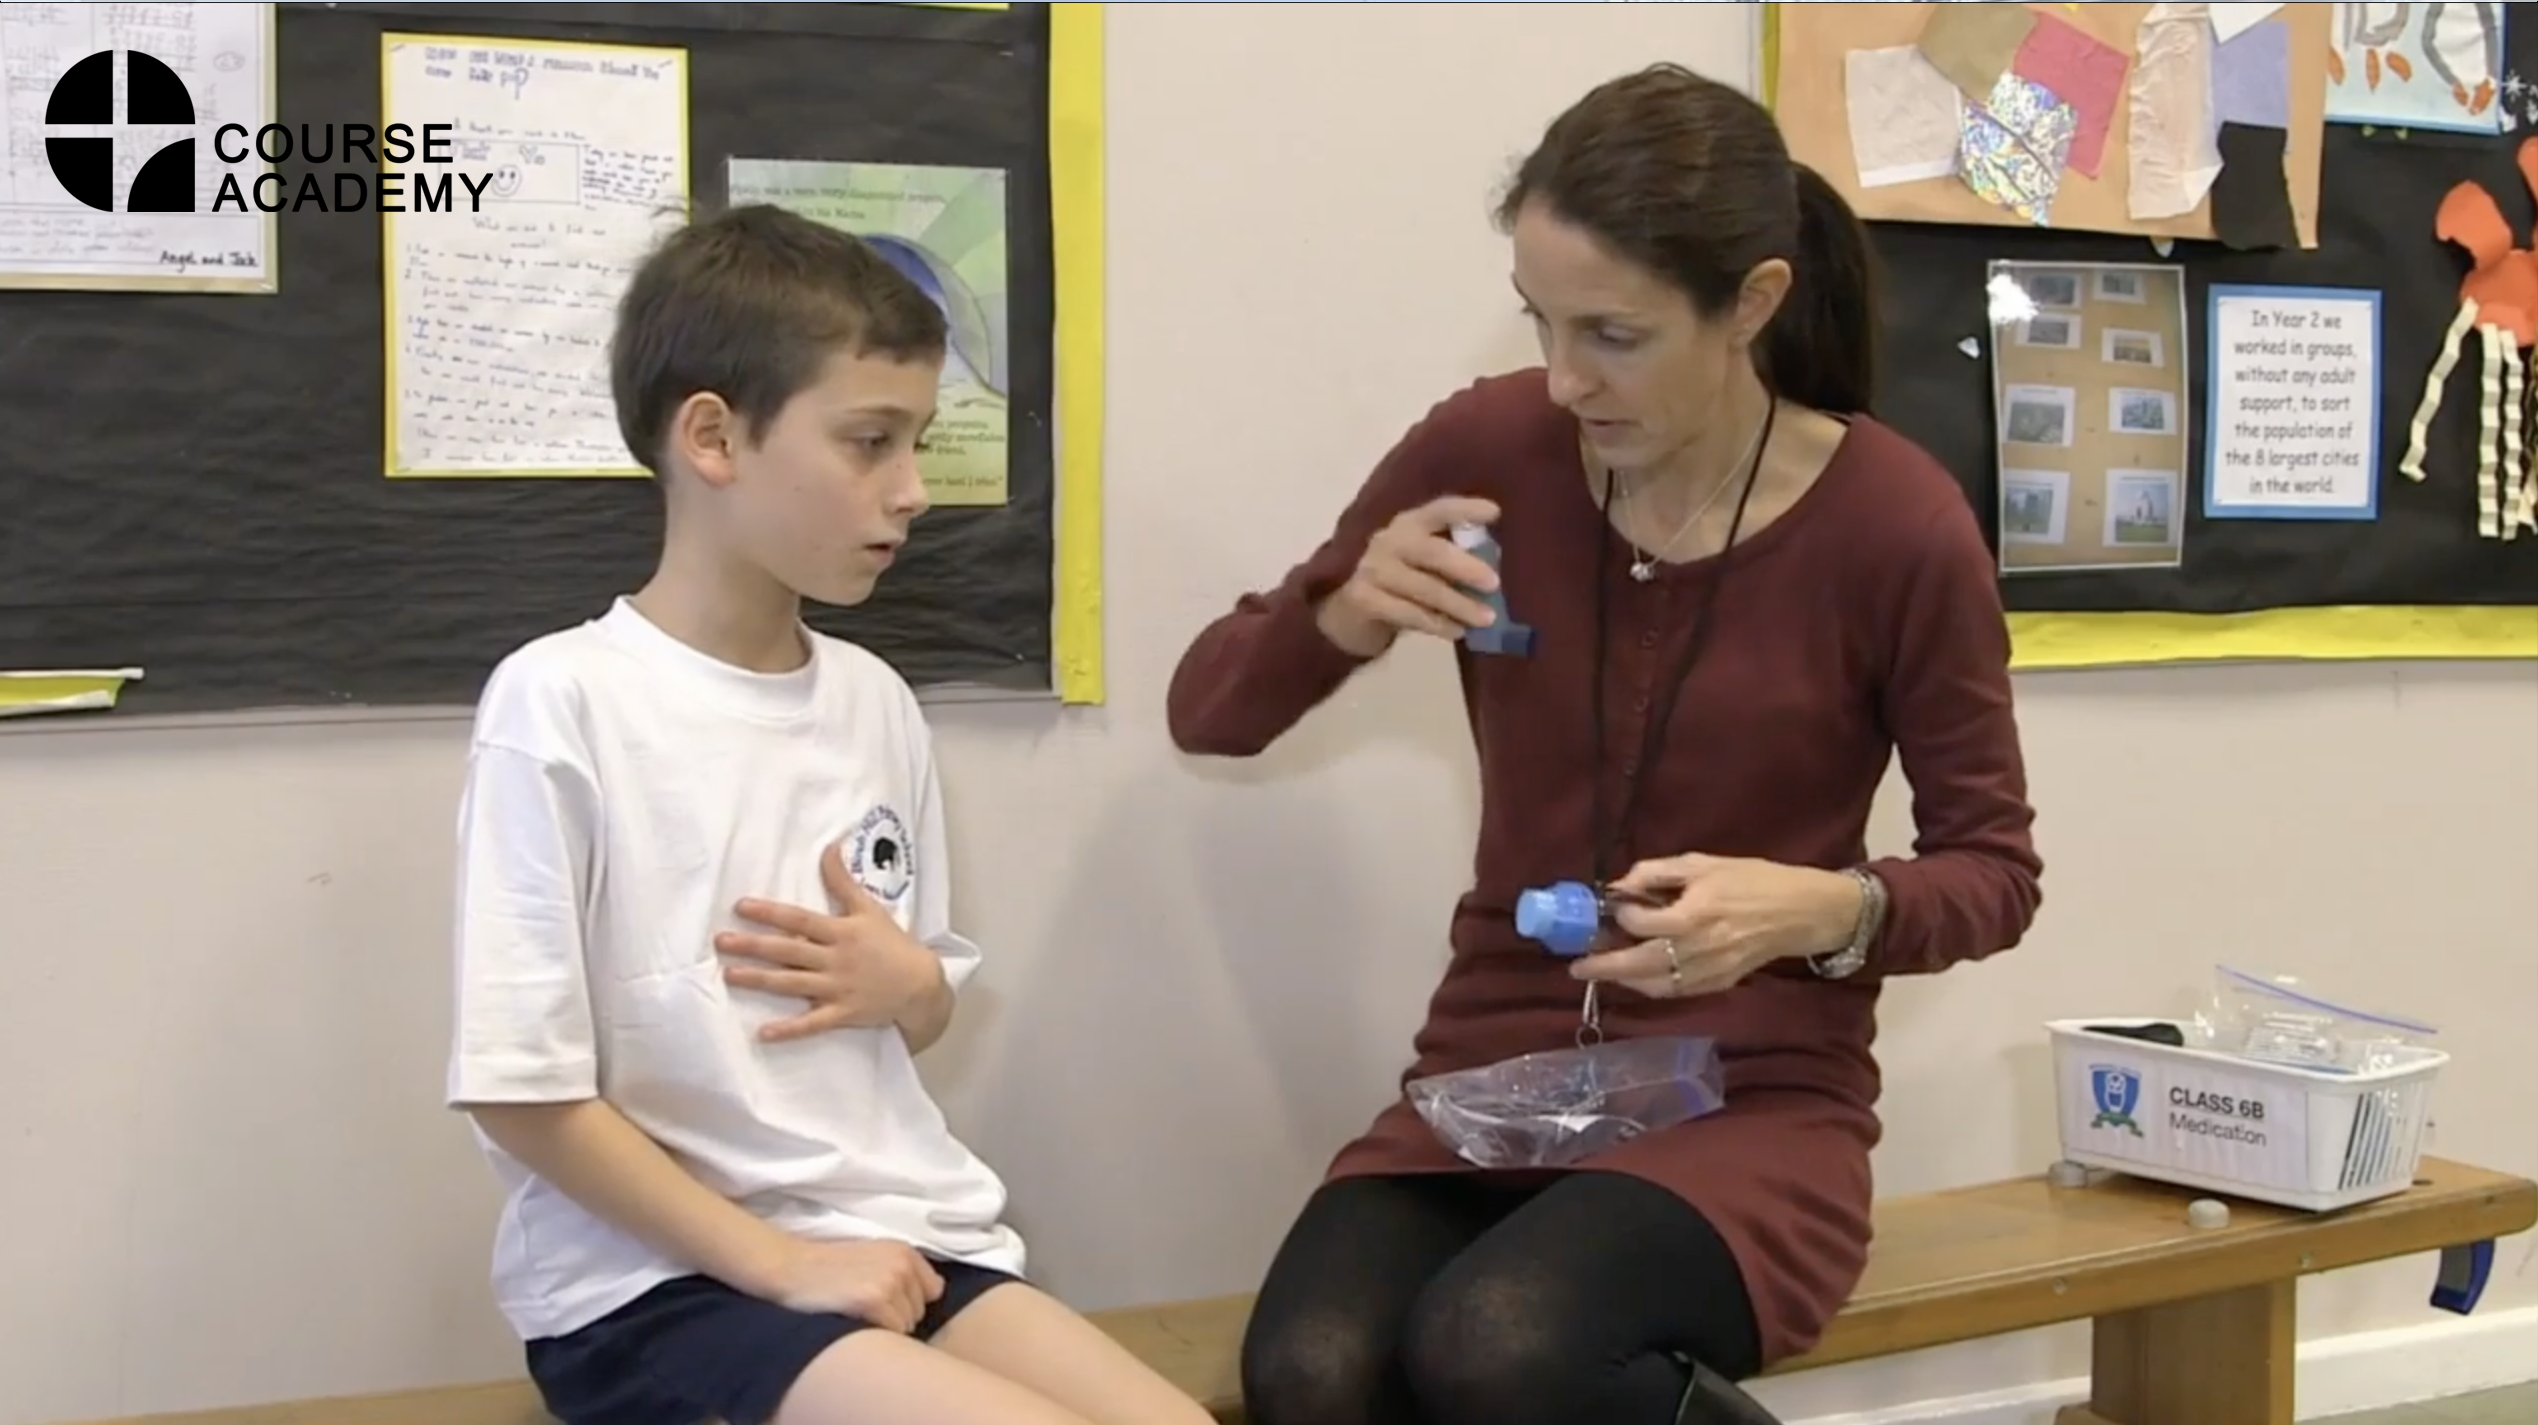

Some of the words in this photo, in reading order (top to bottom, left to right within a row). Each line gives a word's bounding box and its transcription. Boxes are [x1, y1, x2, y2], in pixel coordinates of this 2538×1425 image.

[160, 250, 197, 274] Angel
[201, 252, 224, 265] and
[2251, 309, 2269, 328] In
[2273, 311, 2307, 329] Year
[2310, 311, 2320, 329] 2
[2323, 316, 2342, 330] we
[2234, 338, 2287, 356] worked
[2290, 338, 2304, 356] in
[2307, 343, 2358, 361] groups,
[2234, 365, 2288, 383] without
[2292, 371, 2318, 388] any
[2320, 366, 2356, 384] adult
[2239, 396, 2298, 415] support,
[2302, 396, 2317, 411] to
[2320, 396, 2351, 412] sort
[2234, 421, 2260, 438] the
[2263, 421, 2335, 442] population
[2338, 420, 2354, 439] of
[2225, 448, 2251, 466] the
[2255, 448, 2265, 466] 8
[2268, 448, 2319, 472] largest
[2322, 449, 2360, 467] cities
[2249, 476, 2263, 494] in
[2266, 476, 2290, 494] the
[2293, 475, 2336, 494] world.
[2168, 1086, 2234, 1115] CLASS
[2238, 1099, 2265, 1120] 6B
[2168, 1111, 2267, 1147] Medication
